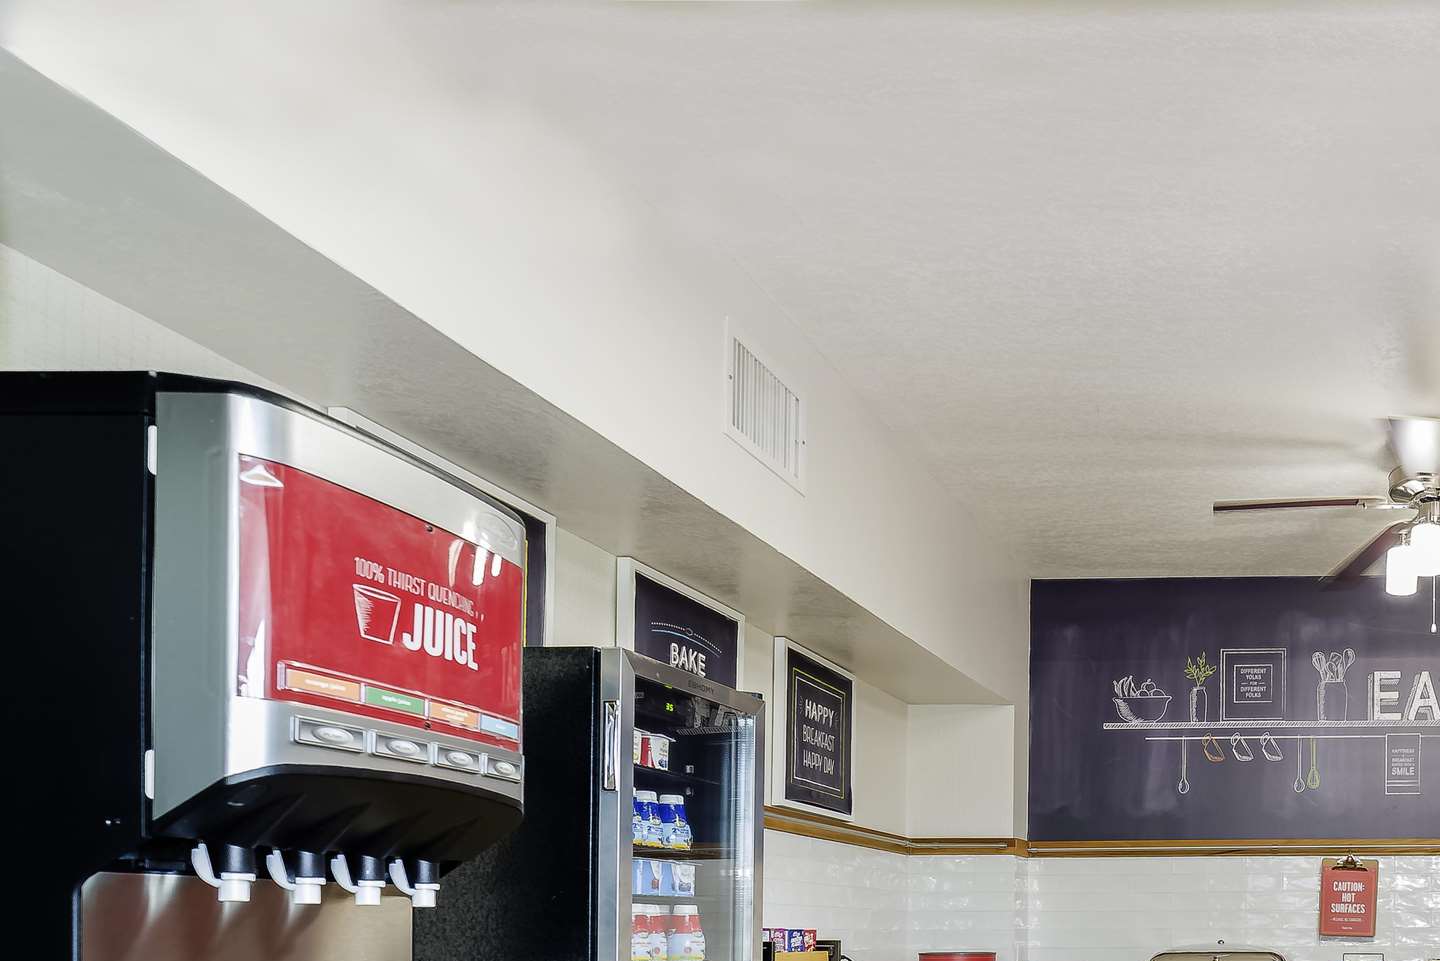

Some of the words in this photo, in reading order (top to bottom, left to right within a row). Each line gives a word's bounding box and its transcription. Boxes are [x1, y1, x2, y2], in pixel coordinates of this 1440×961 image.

[354, 557, 385, 584] 100%
[387, 567, 426, 596] THIRST
[402, 602, 479, 671] JUICE
[670, 642, 706, 678] BAKE
[804, 699, 835, 728] HAPPY
[802, 724, 835, 752] BREAKFAST
[803, 749, 823, 771] HAPPY
[823, 756, 835, 775] DAY
[1391, 767, 1415, 775] SMILE
[1333, 881, 1365, 892] CAUTION:
[1341, 892, 1356, 902] HOT
[1330, 903, 1366, 913] SURFACES
